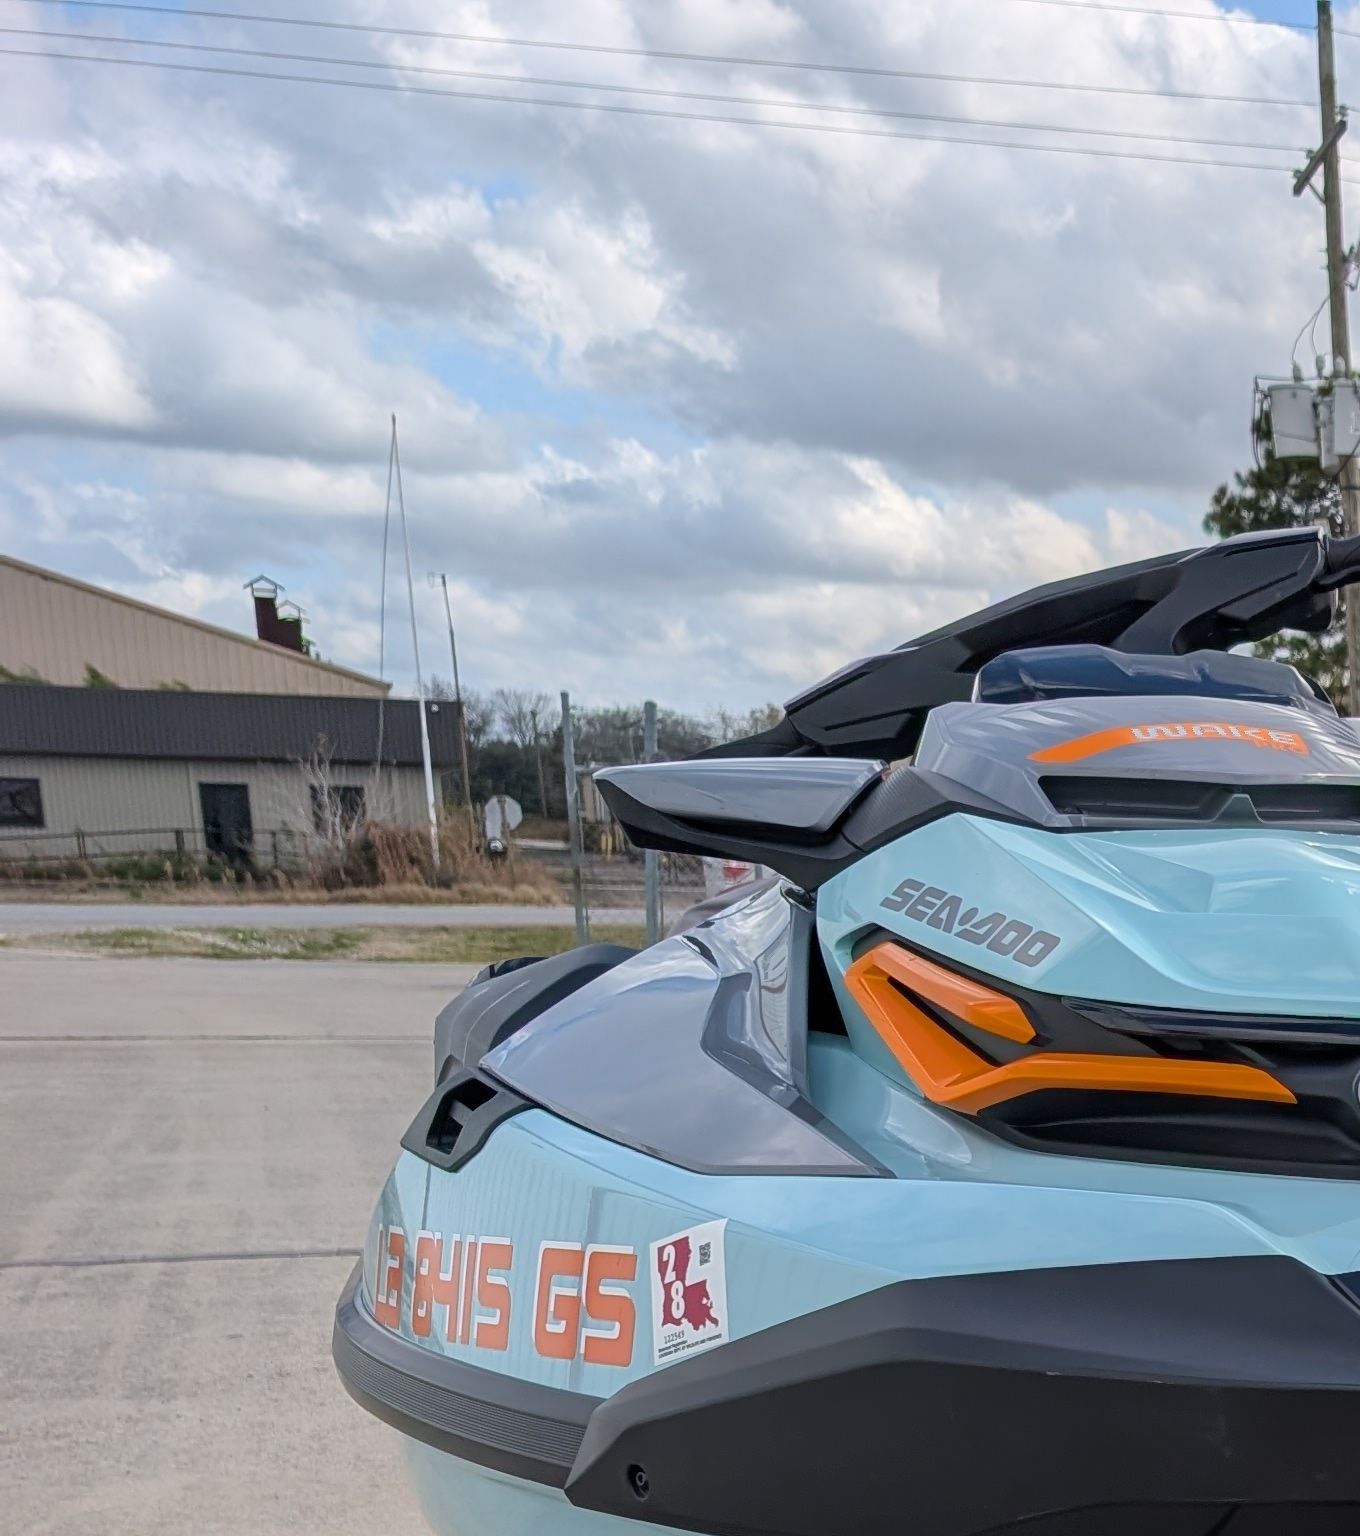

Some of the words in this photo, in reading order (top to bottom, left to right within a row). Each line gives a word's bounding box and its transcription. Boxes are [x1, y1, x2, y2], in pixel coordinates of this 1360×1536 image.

[662, 1244, 677, 1284] 2
[411, 1230, 514, 1352] 8415
[532, 1240, 637, 1368] GS
[670, 1280, 686, 1320] 8
